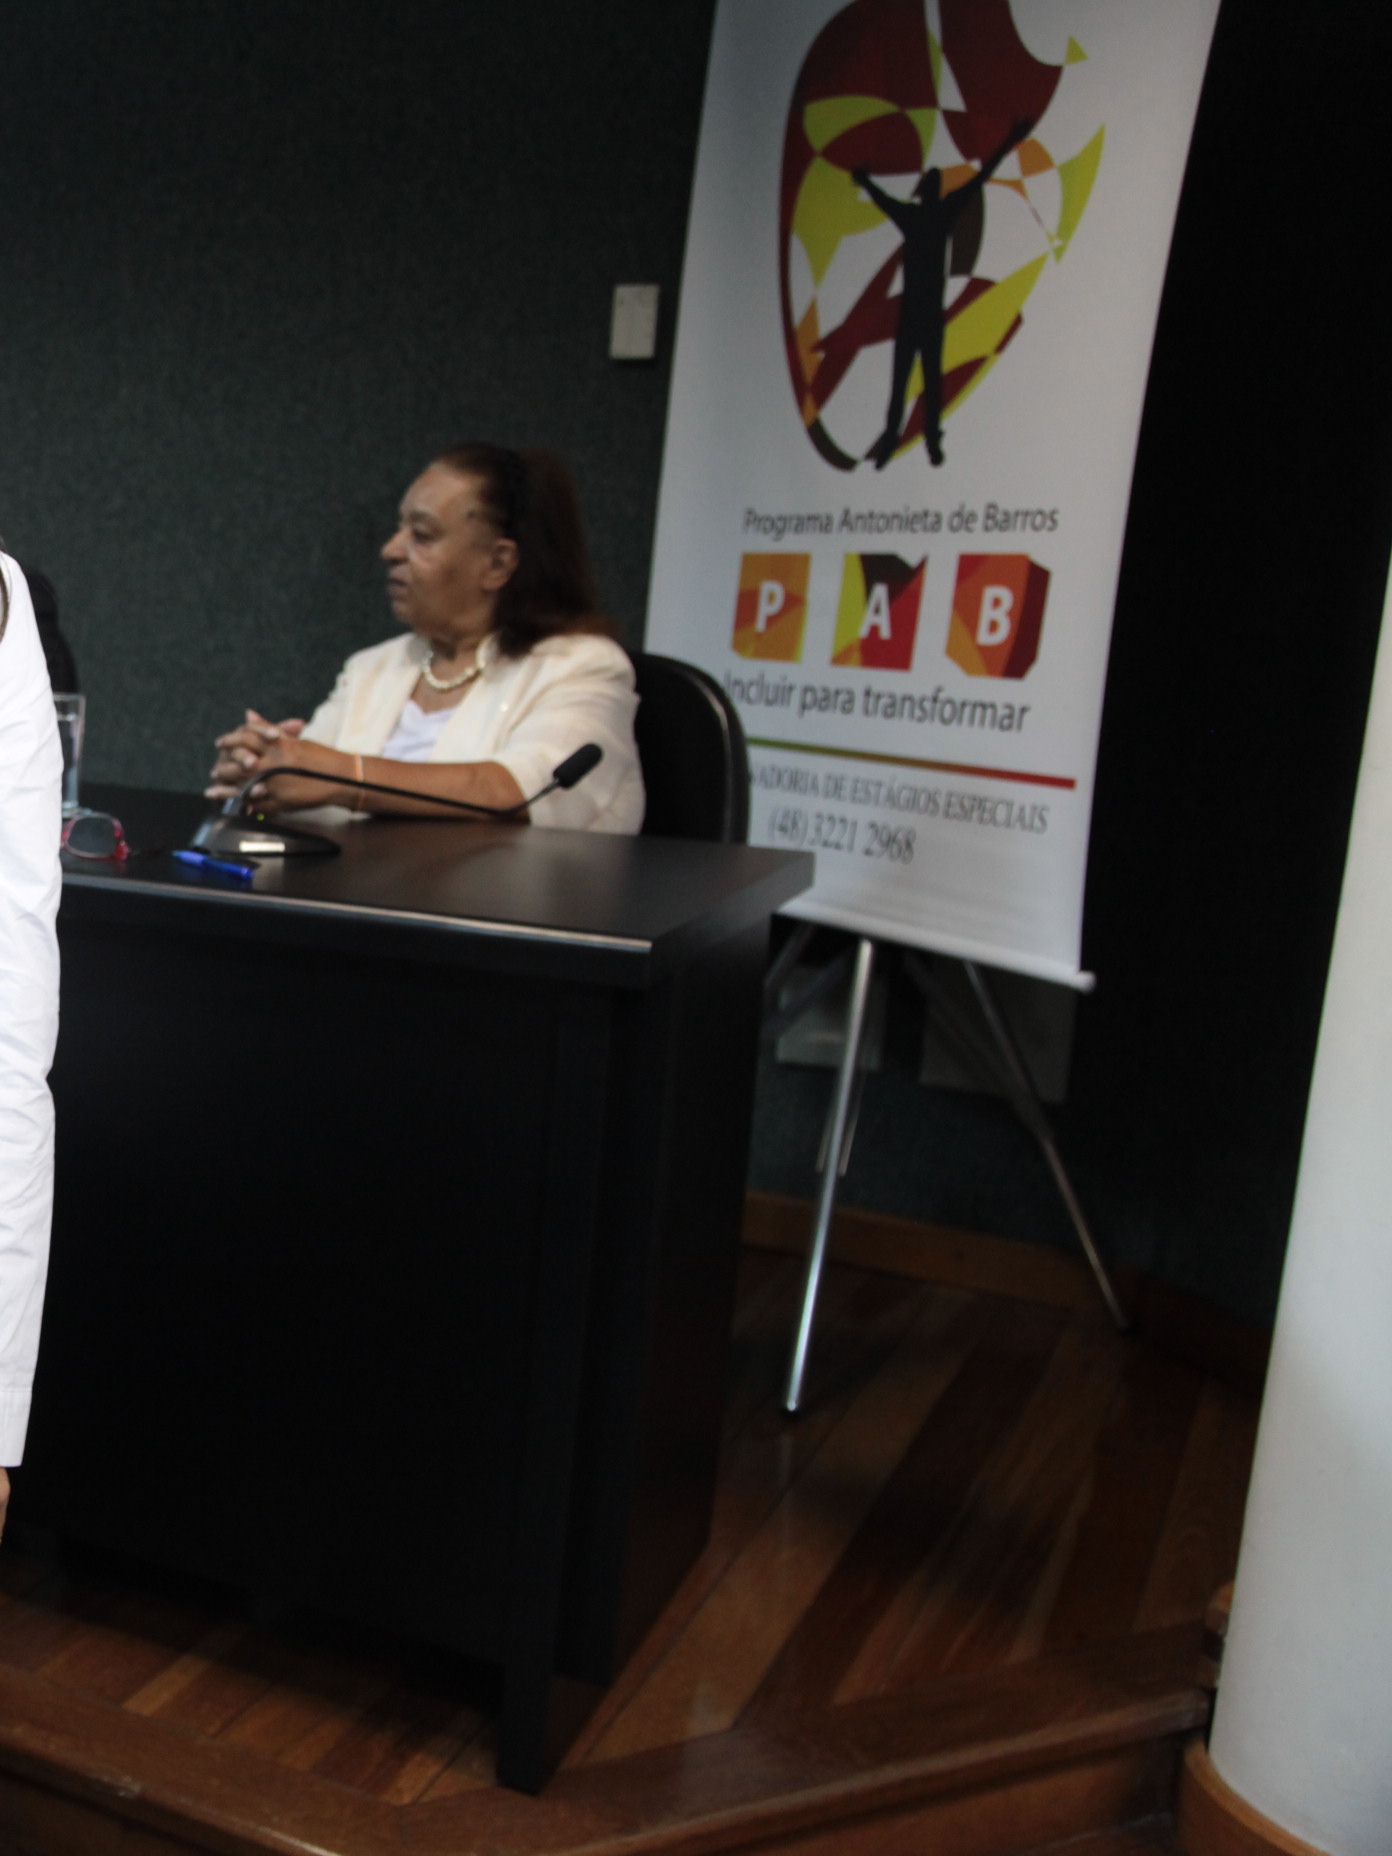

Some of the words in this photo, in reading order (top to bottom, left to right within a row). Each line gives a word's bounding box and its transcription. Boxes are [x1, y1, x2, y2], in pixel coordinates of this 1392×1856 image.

[744, 507, 833, 541] Programa
[839, 505, 943, 534] Antonieta
[947, 504, 978, 533] de
[982, 502, 1059, 533] Barros
[757, 582, 785, 632] P
[860, 584, 891, 640] A
[978, 587, 1014, 645] B
[724, 671, 795, 709] Incluir
[798, 682, 856, 717] para
[864, 685, 1030, 732] transformar
[823, 771, 846, 802] DE
[850, 774, 940, 818] ESTÁGIOS
[942, 790, 1051, 835] ESPECIAIS
[770, 805, 807, 847] (48)
[809, 811, 859, 853] 3221
[863, 820, 918, 865] 2968
